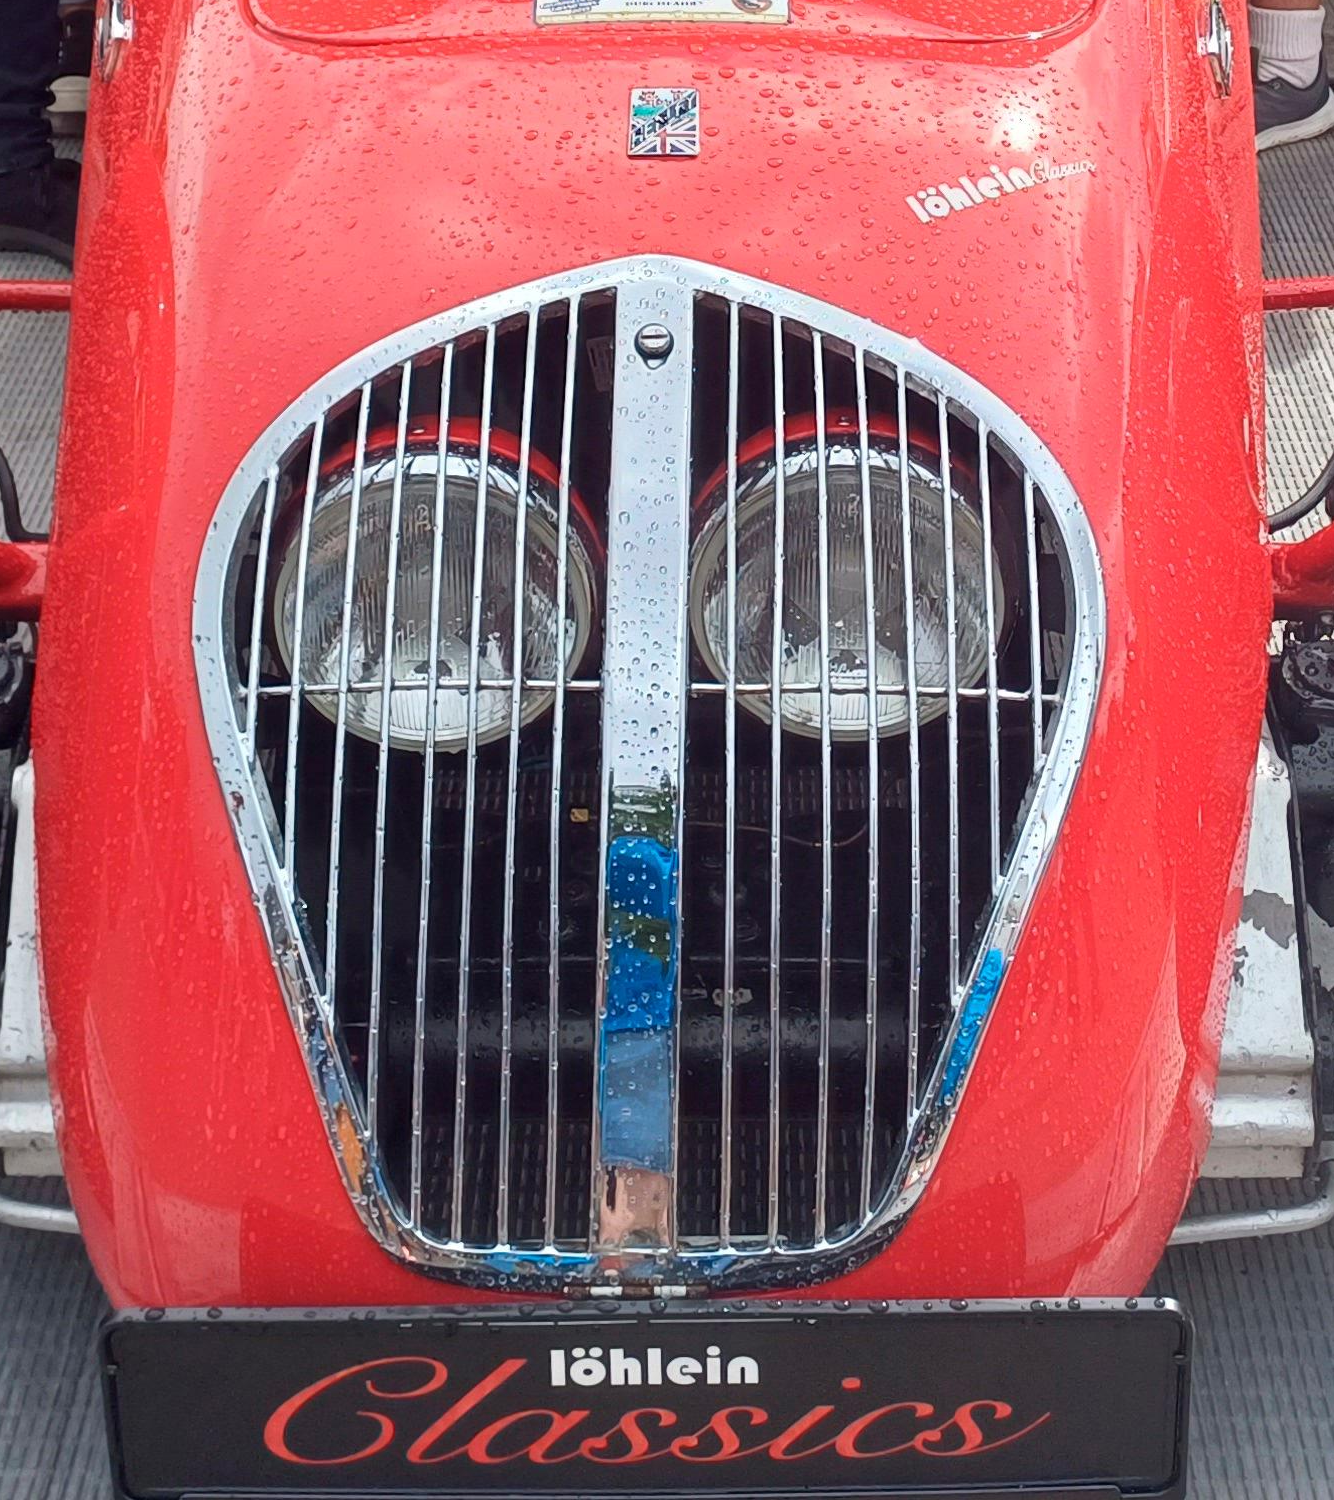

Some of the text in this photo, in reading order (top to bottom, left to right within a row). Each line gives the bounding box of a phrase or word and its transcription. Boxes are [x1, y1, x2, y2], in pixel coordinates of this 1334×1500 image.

[905, 164, 1035, 225] löhlein
[548, 1346, 760, 1390] löhlein
[264, 1355, 1051, 1465] Classics
